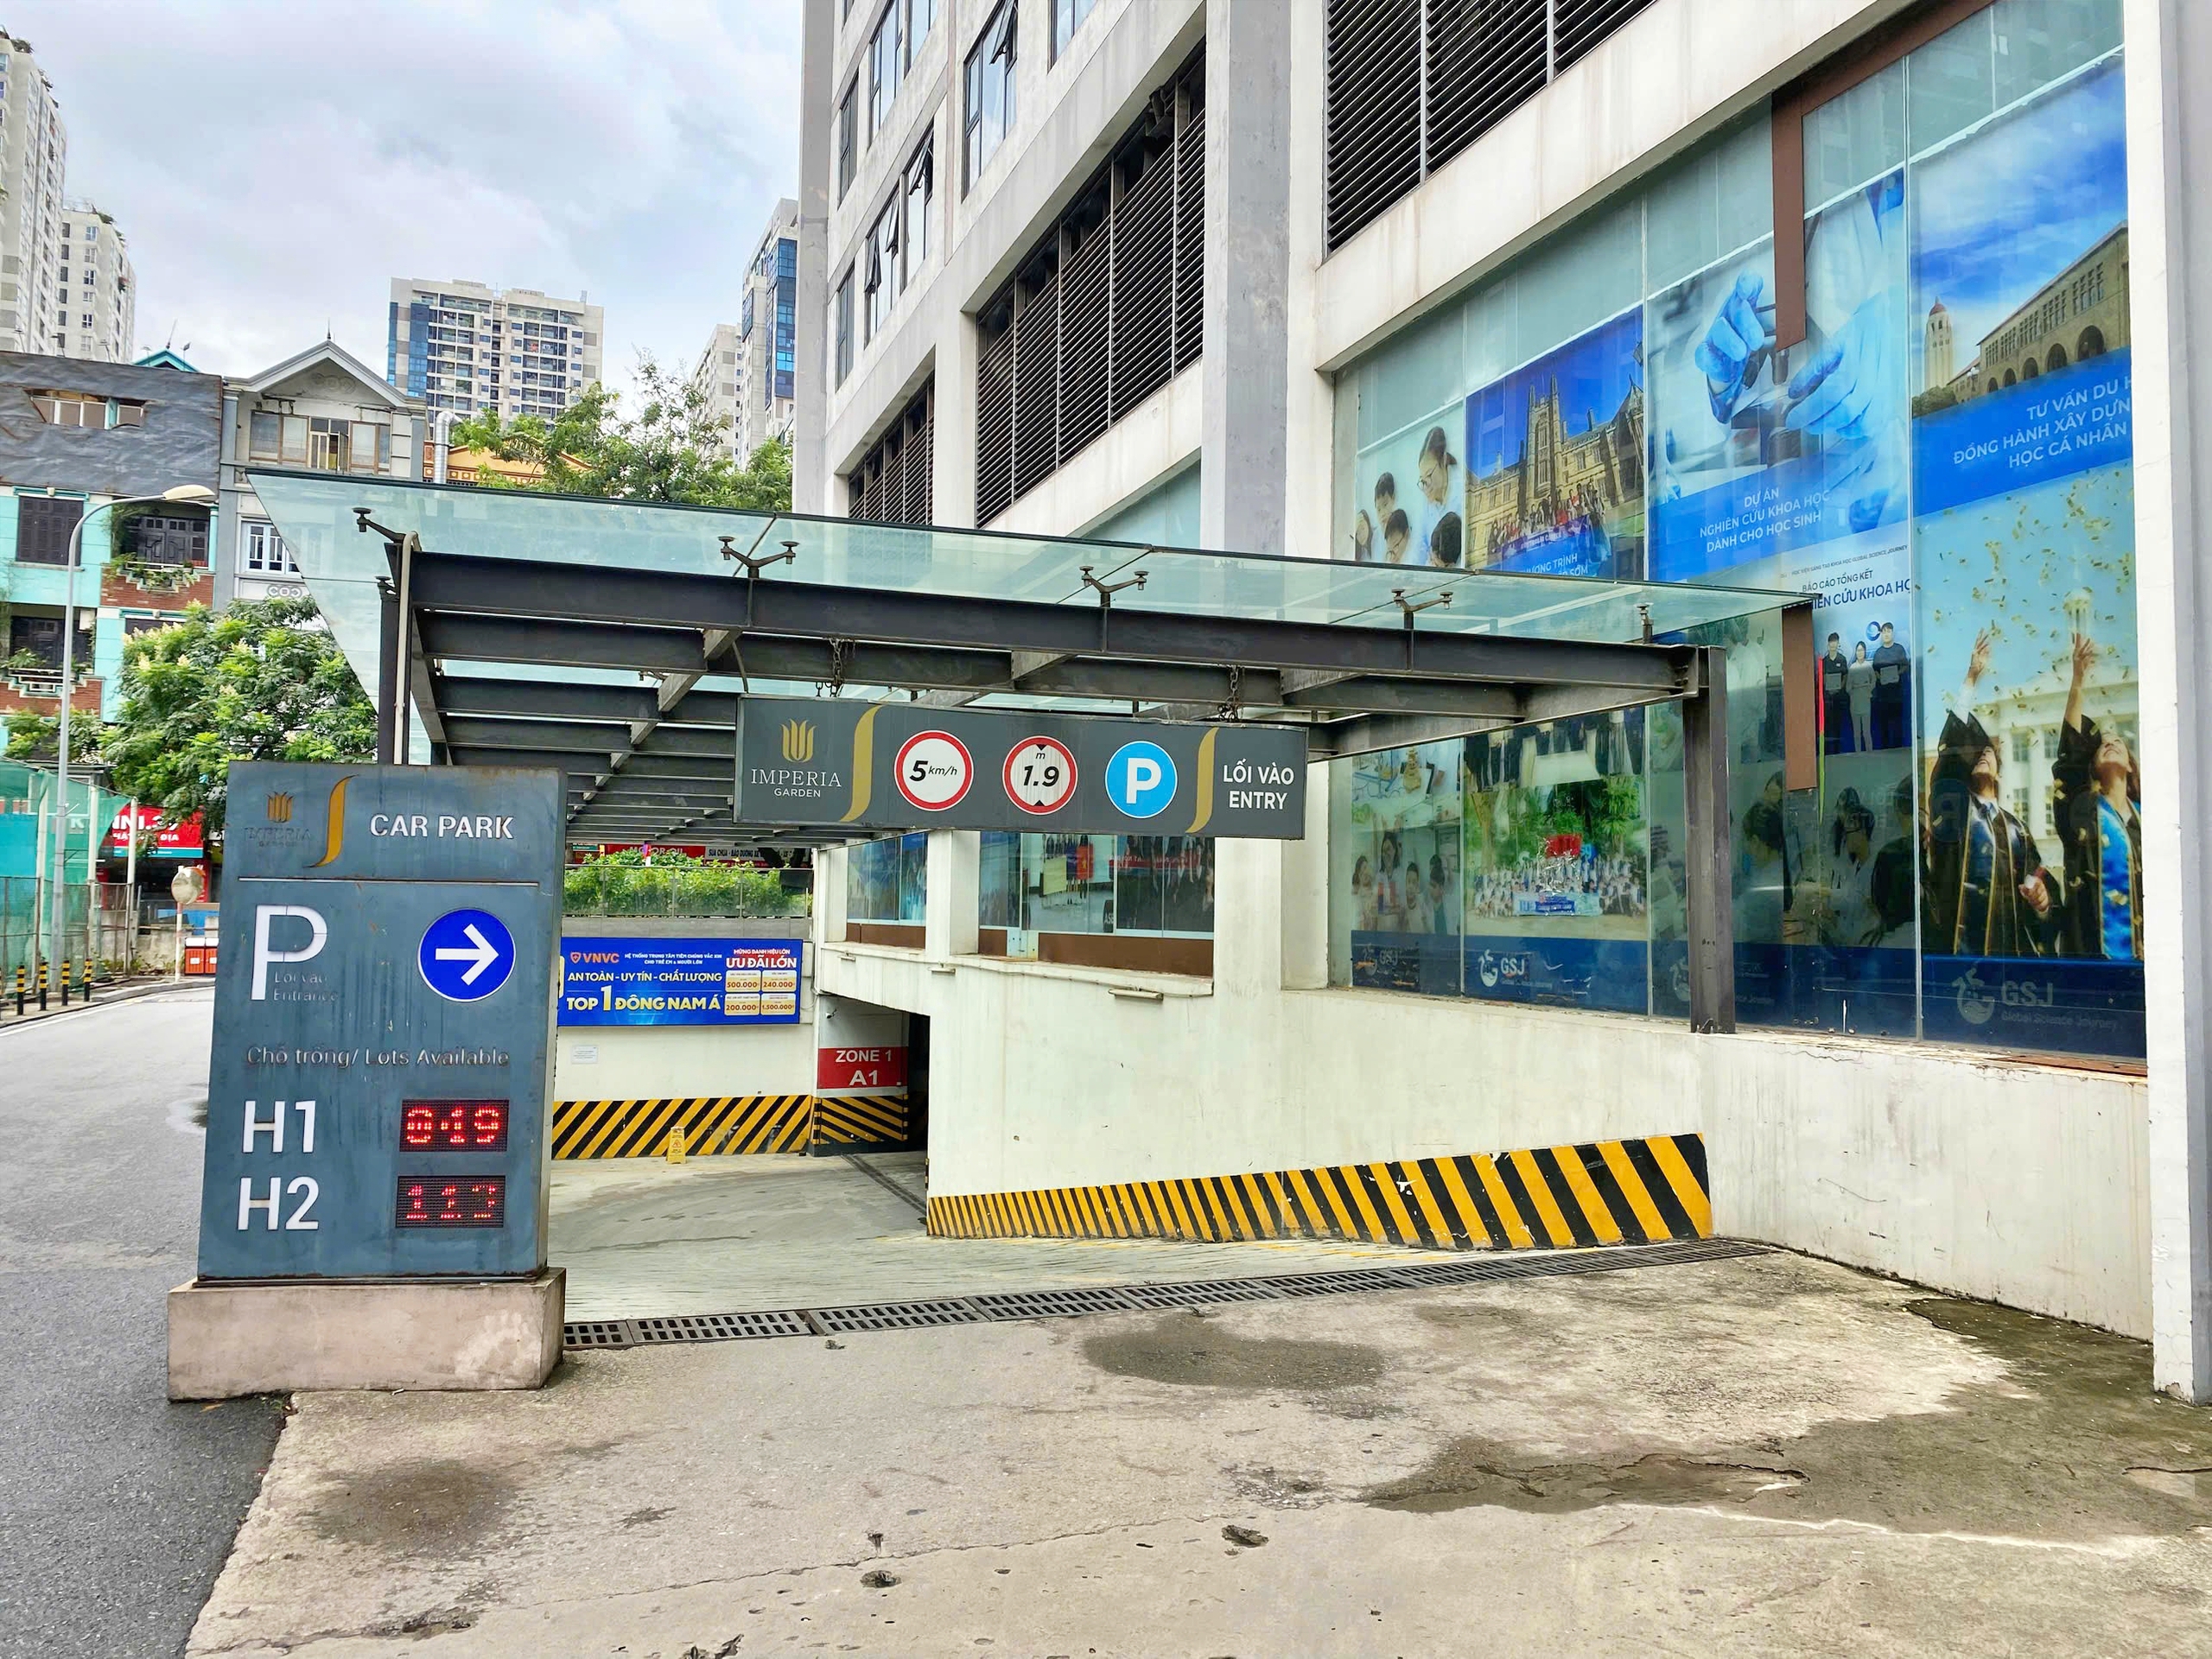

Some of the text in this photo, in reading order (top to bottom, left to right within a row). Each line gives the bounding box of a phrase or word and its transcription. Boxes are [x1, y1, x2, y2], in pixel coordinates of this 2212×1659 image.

[2027, 400, 2049, 420] TƯ
[2093, 378, 2119, 400] DU
[1954, 439, 1999, 465] ĐỒNG
[2003, 422, 2050, 449] HÀNH
[2054, 410, 2087, 435] XÂY
[2009, 420, 2127, 468] HỌC CÁ NHÂN
[1744, 486, 1762, 508] DỰ
[1768, 498, 1801, 518] KHOA
[1803, 489, 1831, 512] HỌC
[1739, 525, 1764, 544] CHO
[1766, 518, 1791, 541] HỌC
[1793, 509, 1821, 530] SINH
[1859, 582, 1893, 601] KHOA
[1035, 752, 1046, 760] m
[751, 768, 842, 787] IMPERIA
[1023, 765, 1060, 787] 1.9
[1126, 757, 1162, 804] P
[1224, 758, 1294, 785] LỐI VÀO
[773, 787, 821, 798] GARDEN
[1229, 790, 1287, 810] ENTRY
[370, 813, 516, 840] CAR PARK
[251, 904, 328, 1001] P
[583, 952, 620, 963] VNVC
[726, 954, 798, 969] ƯU ĐÃI LỚN
[568, 972, 584, 982] AN
[584, 969, 614, 982] TOÀN
[620, 972, 637, 982] UY
[637, 969, 652, 982] TÍN
[658, 968, 684, 982] CHẤT
[684, 972, 723, 983] LƯỢNG
[1501, 957, 1525, 976] GSJ
[566, 996, 599, 1011] TOP
[601, 985, 612, 1012] 1
[614, 995, 666, 1011] ĐÔNG
[667, 997, 707, 1011] NAM
[2001, 980, 2053, 1007] GSJ
[365, 1047, 410, 1065] Lots
[416, 1047, 511, 1066] Available
[835, 1049, 892, 1063] ZONE 1
[849, 1070, 879, 1086] A1
[241, 1100, 316, 1154] H1
[237, 1176, 320, 1230] H2
